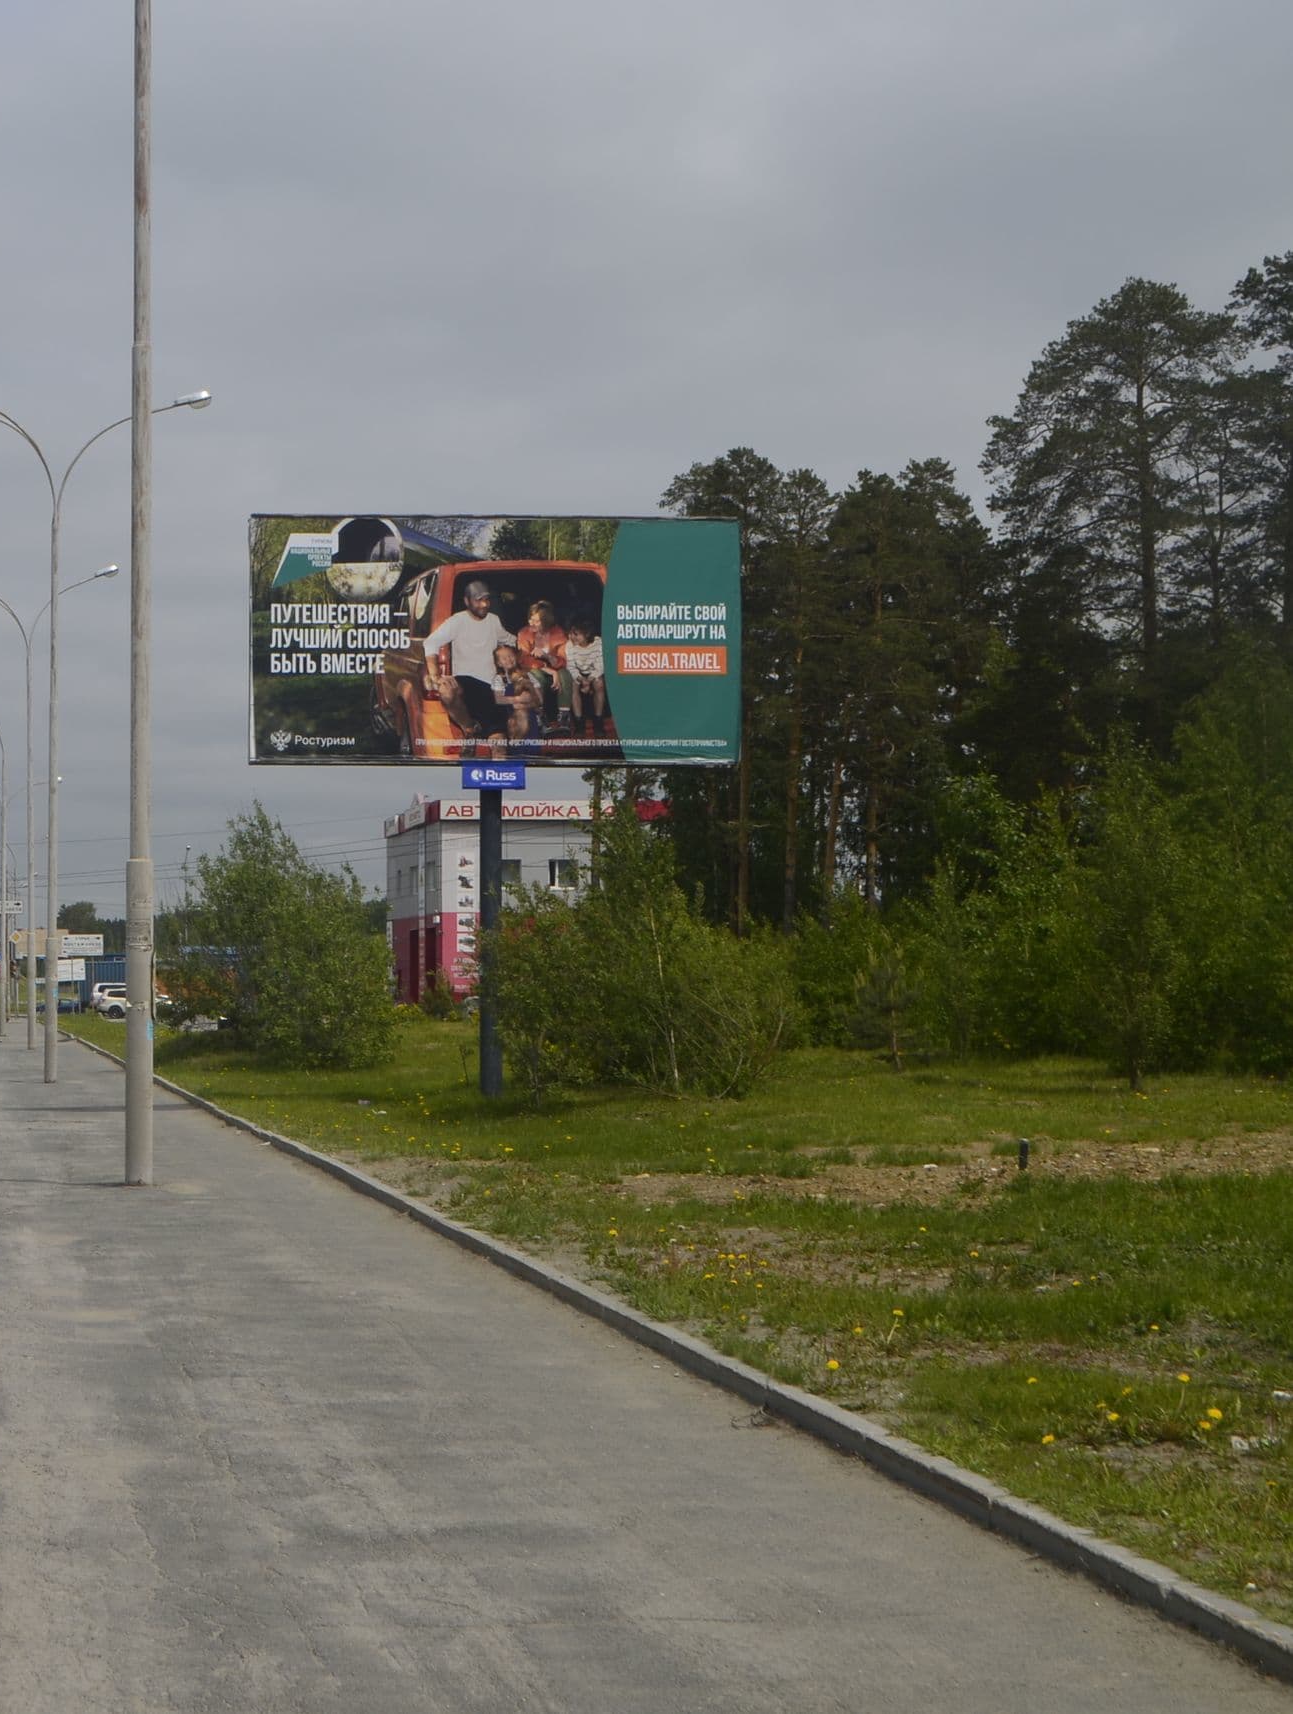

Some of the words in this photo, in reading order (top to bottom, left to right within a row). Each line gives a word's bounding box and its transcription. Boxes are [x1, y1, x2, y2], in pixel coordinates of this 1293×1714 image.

[270, 603, 390, 624] ПУТЕШЕСТВИЯ
[617, 603, 691, 620] ВЫБИРАЙТЕ
[694, 603, 726, 621] СВОЙ
[270, 625, 343, 649] ЛУЧШИЙ
[346, 629, 411, 649] СПОСОБ
[616, 624, 707, 639] АВТОМАРШРУТ
[709, 625, 726, 640] НА
[270, 653, 317, 674] БЫТЬ
[320, 653, 386, 674] ВМЕСТЕ
[623, 652, 721, 670] RUSSIA.TRAVEL
[294, 734, 356, 747] Ростуризм
[485, 769, 517, 781] Russ
[445, 802, 581, 817] АВМОЙКА
